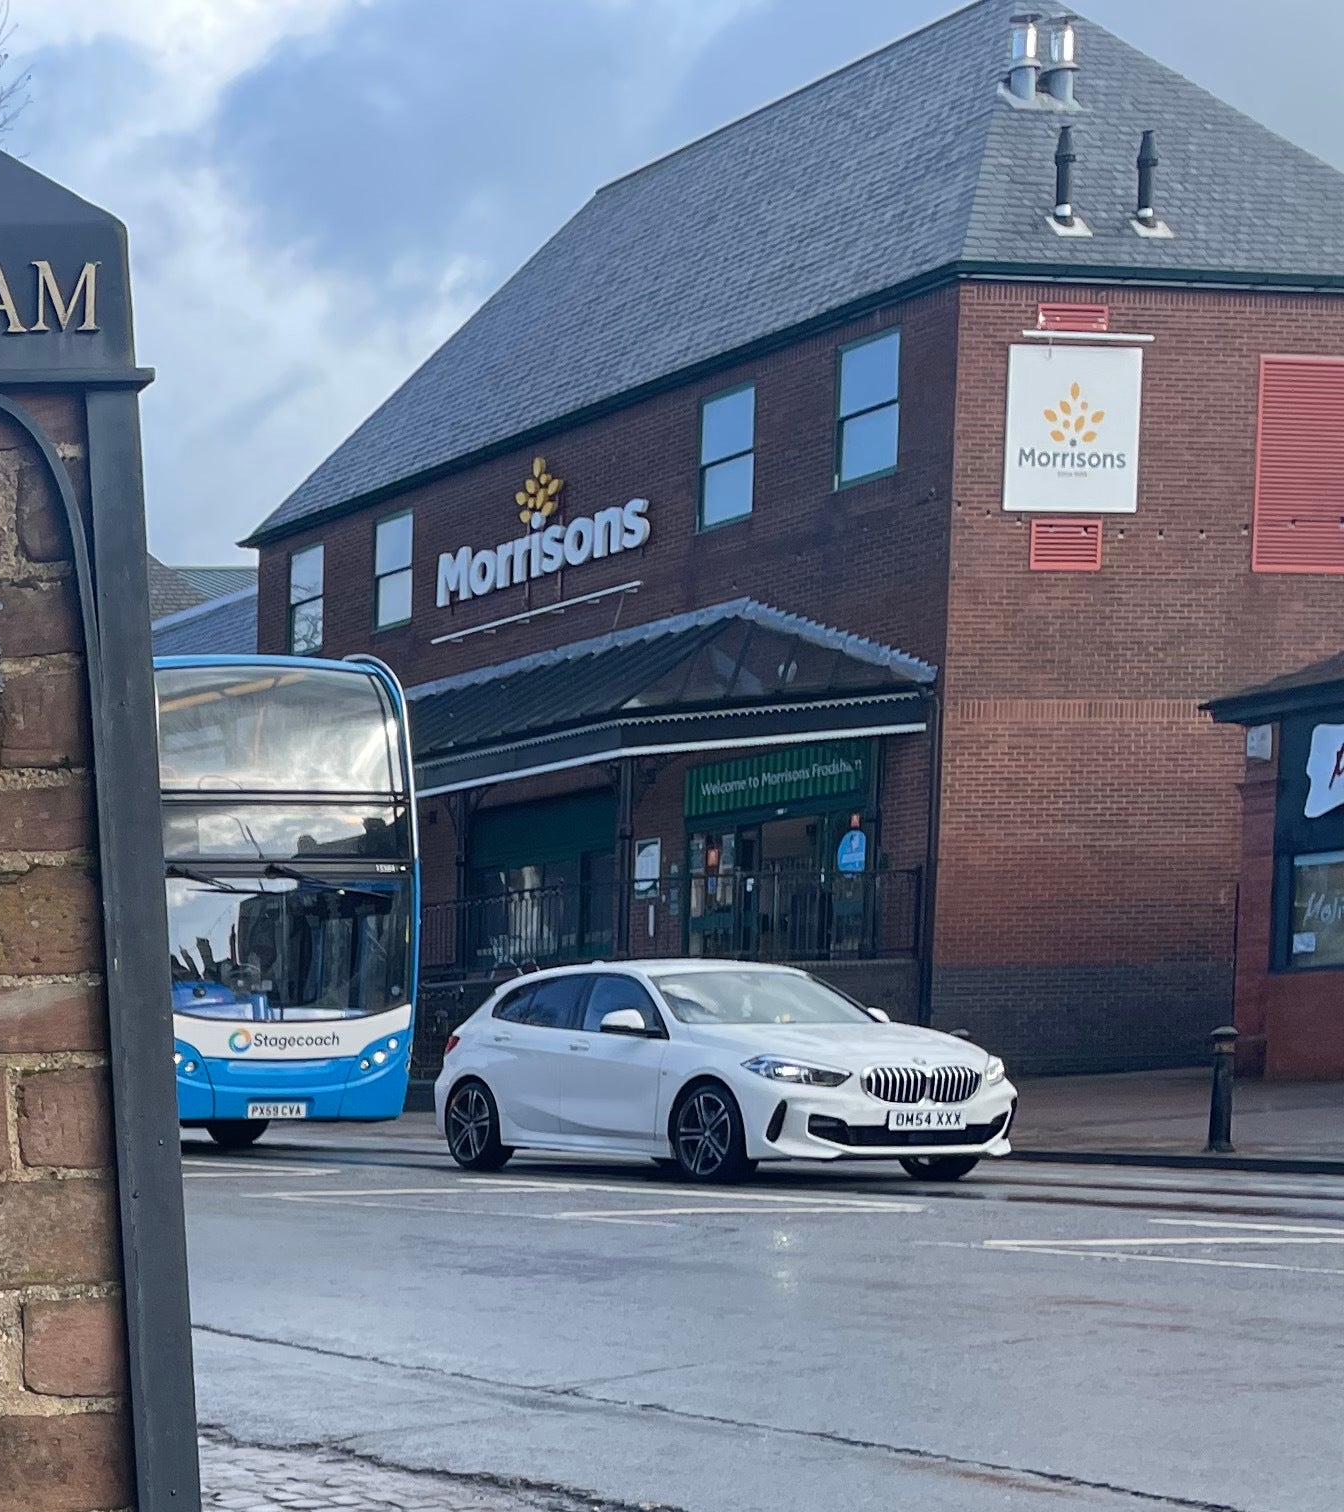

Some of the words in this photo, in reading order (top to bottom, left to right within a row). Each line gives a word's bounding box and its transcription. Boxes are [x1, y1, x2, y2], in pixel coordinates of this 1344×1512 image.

[1018, 438, 1127, 468] Morrisons
[436, 497, 651, 608] Morrisons
[701, 778, 746, 797] Welcome
[749, 776, 760, 789] to
[762, 767, 810, 787] Morrisons
[253, 1032, 340, 1050] Stagecoach
